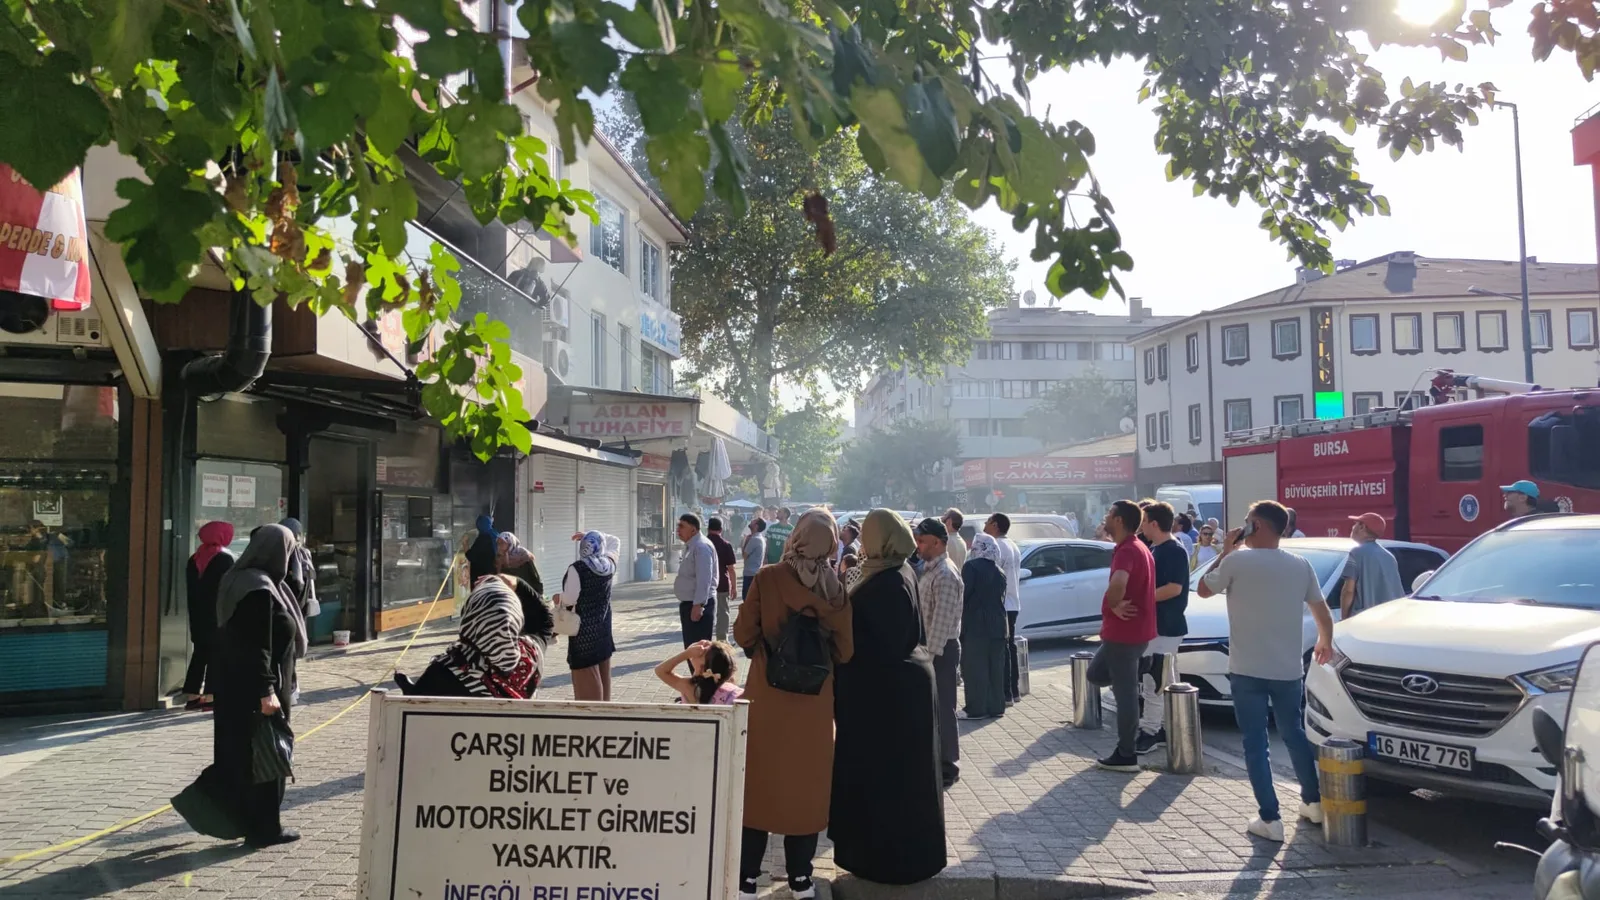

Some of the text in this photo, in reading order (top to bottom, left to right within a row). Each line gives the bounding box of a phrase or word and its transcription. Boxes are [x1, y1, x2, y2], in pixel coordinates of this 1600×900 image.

[0, 222, 53, 256] PERDE
[593, 404, 667, 418] ASLAN
[577, 418, 683, 434] TUHAFİYE
[1313, 440, 1349, 457] BURSA
[993, 471, 1086, 481] ÇAMAŞIR
[1009, 461, 1070, 469] PINAR
[1284, 478, 1386, 499] BÜYÜKŞEHİR İTFAİYESİ
[450, 731, 671, 762] ÇARŞI MERKEZİNE
[1376, 737, 1394, 755] 16
[1399, 741, 1431, 762] ANZ
[1436, 746, 1469, 768] 776
[489, 764, 629, 796] BİSİKLET ve
[415, 801, 697, 834] MOTORSİKLET GİRMESİ
[492, 843, 617, 869] YASAKTIR.
